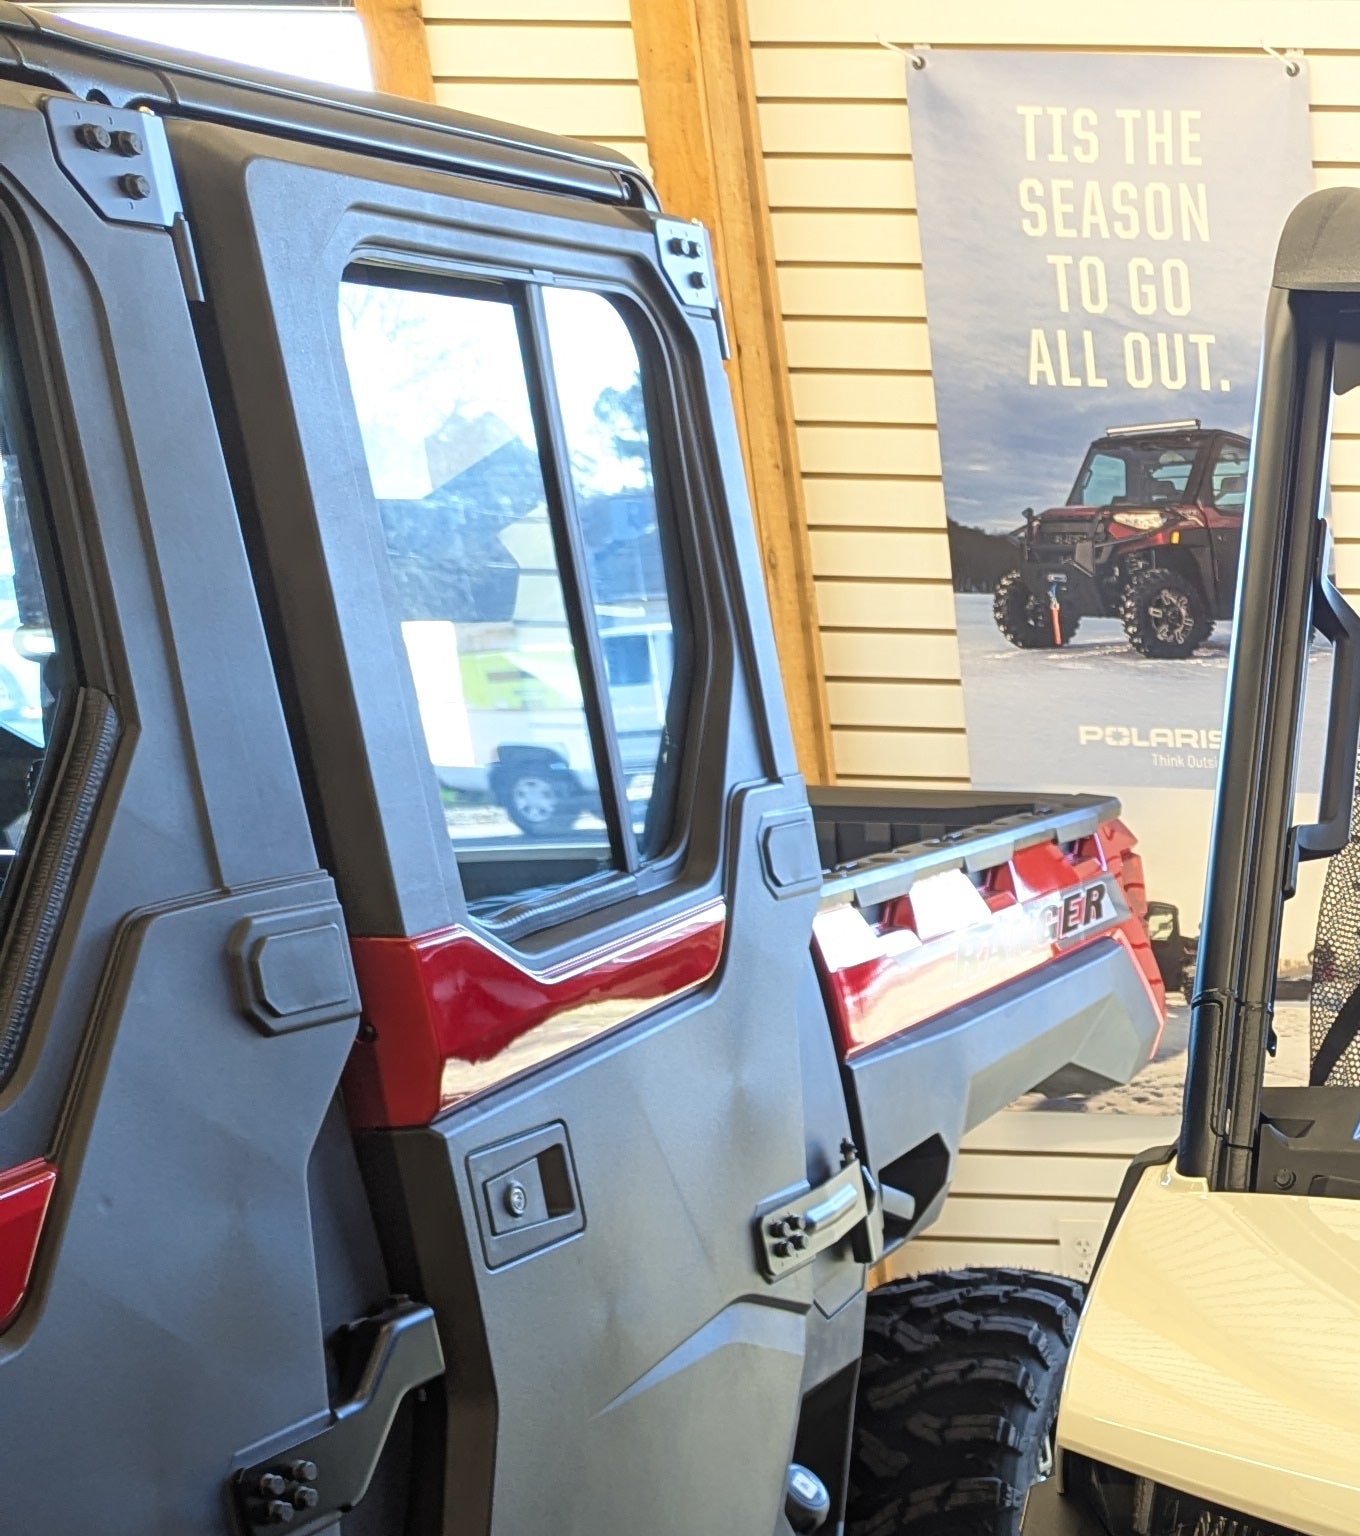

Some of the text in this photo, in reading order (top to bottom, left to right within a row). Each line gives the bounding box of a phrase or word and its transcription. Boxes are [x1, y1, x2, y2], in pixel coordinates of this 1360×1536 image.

[1016, 104, 1203, 166] TIS THE
[1020, 179, 1209, 241] SEASON
[1047, 255, 1192, 317] TO GO
[1028, 328, 1231, 392] ALL OUT.
[1151, 753, 1185, 768] Think
